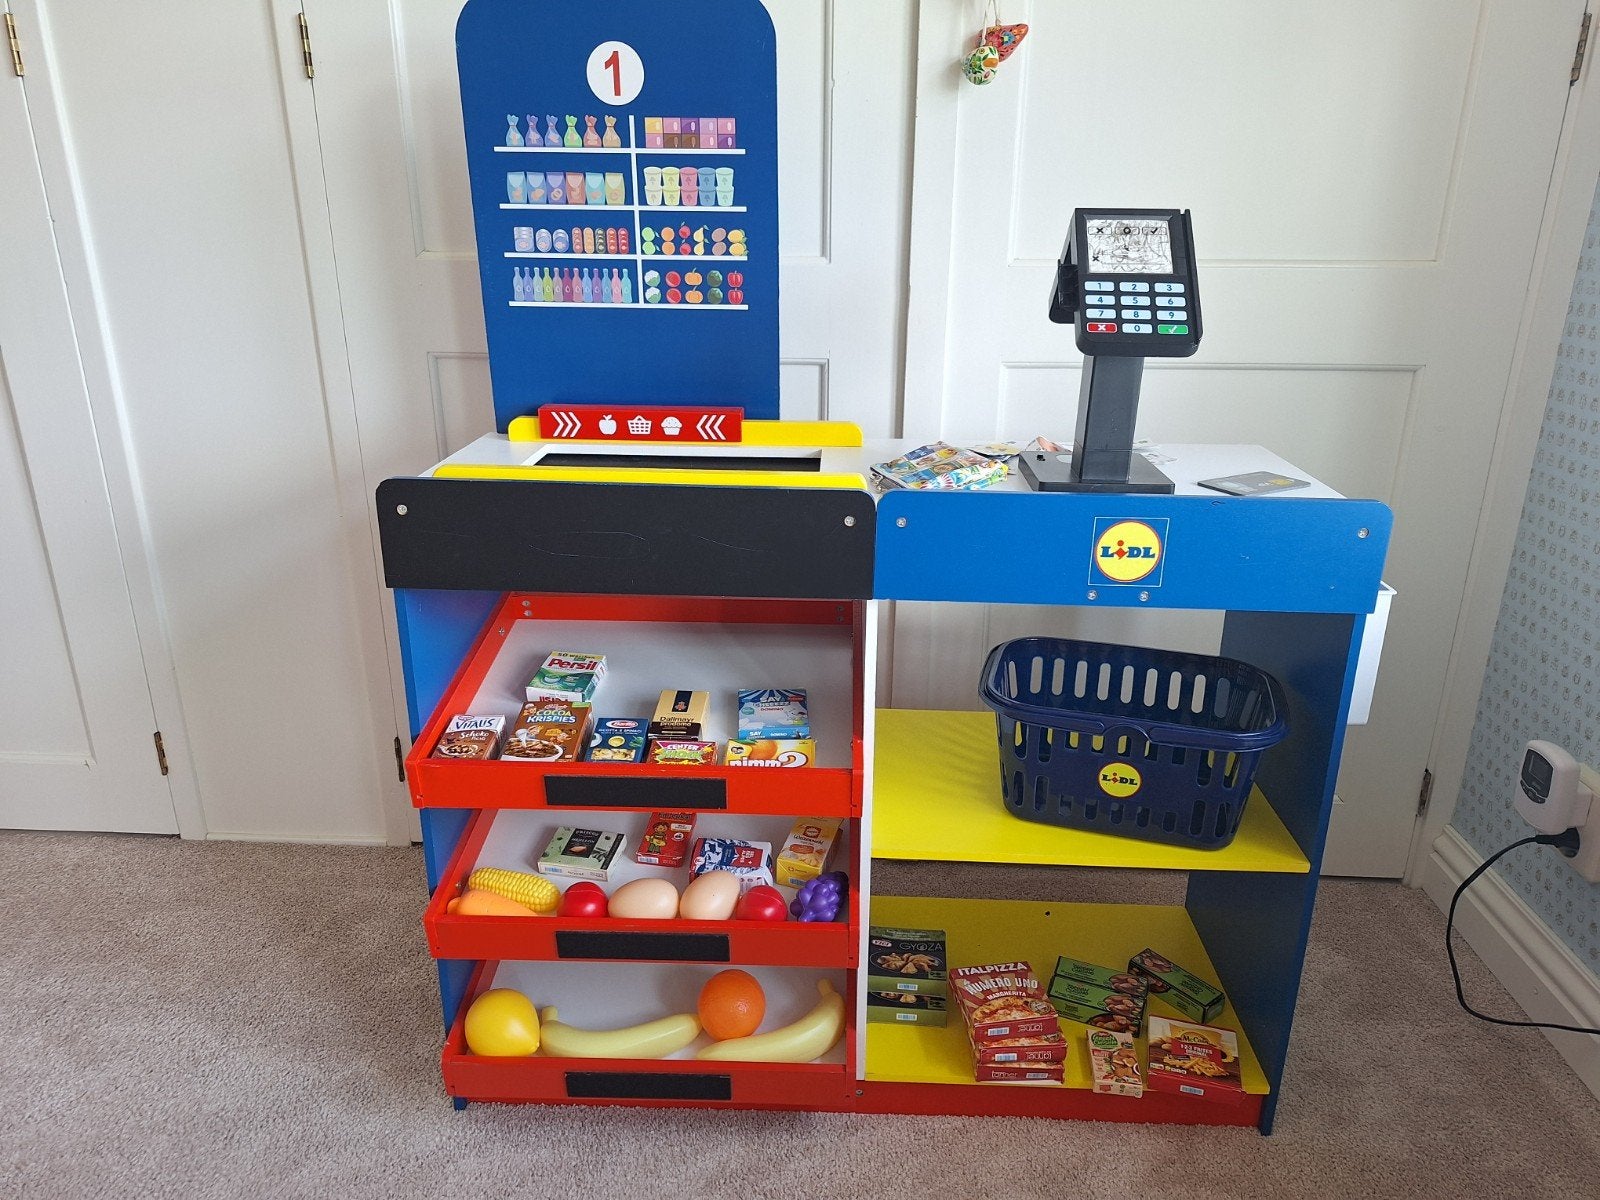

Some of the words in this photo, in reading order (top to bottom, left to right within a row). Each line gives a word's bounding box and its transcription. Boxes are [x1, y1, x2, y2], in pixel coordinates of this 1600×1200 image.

[604, 51, 621, 96] 1
[1097, 282, 1102, 290] 1
[1131, 283, 1138, 291] 2
[1097, 296, 1104, 304] 4
[1098, 310, 1104, 318] 7
[547, 658, 598, 671] Persil
[536, 709, 572, 717] COCOA
[526, 715, 576, 723] KRISPIES
[460, 731, 489, 739] Schoko
[900, 942, 943, 951] GYOZA
[958, 962, 1028, 976] ITALPIZZA
[965, 977, 1012, 995] NUMERO
[1014, 977, 1038, 989] UNO
[986, 990, 1027, 1000] MARGHERITA
